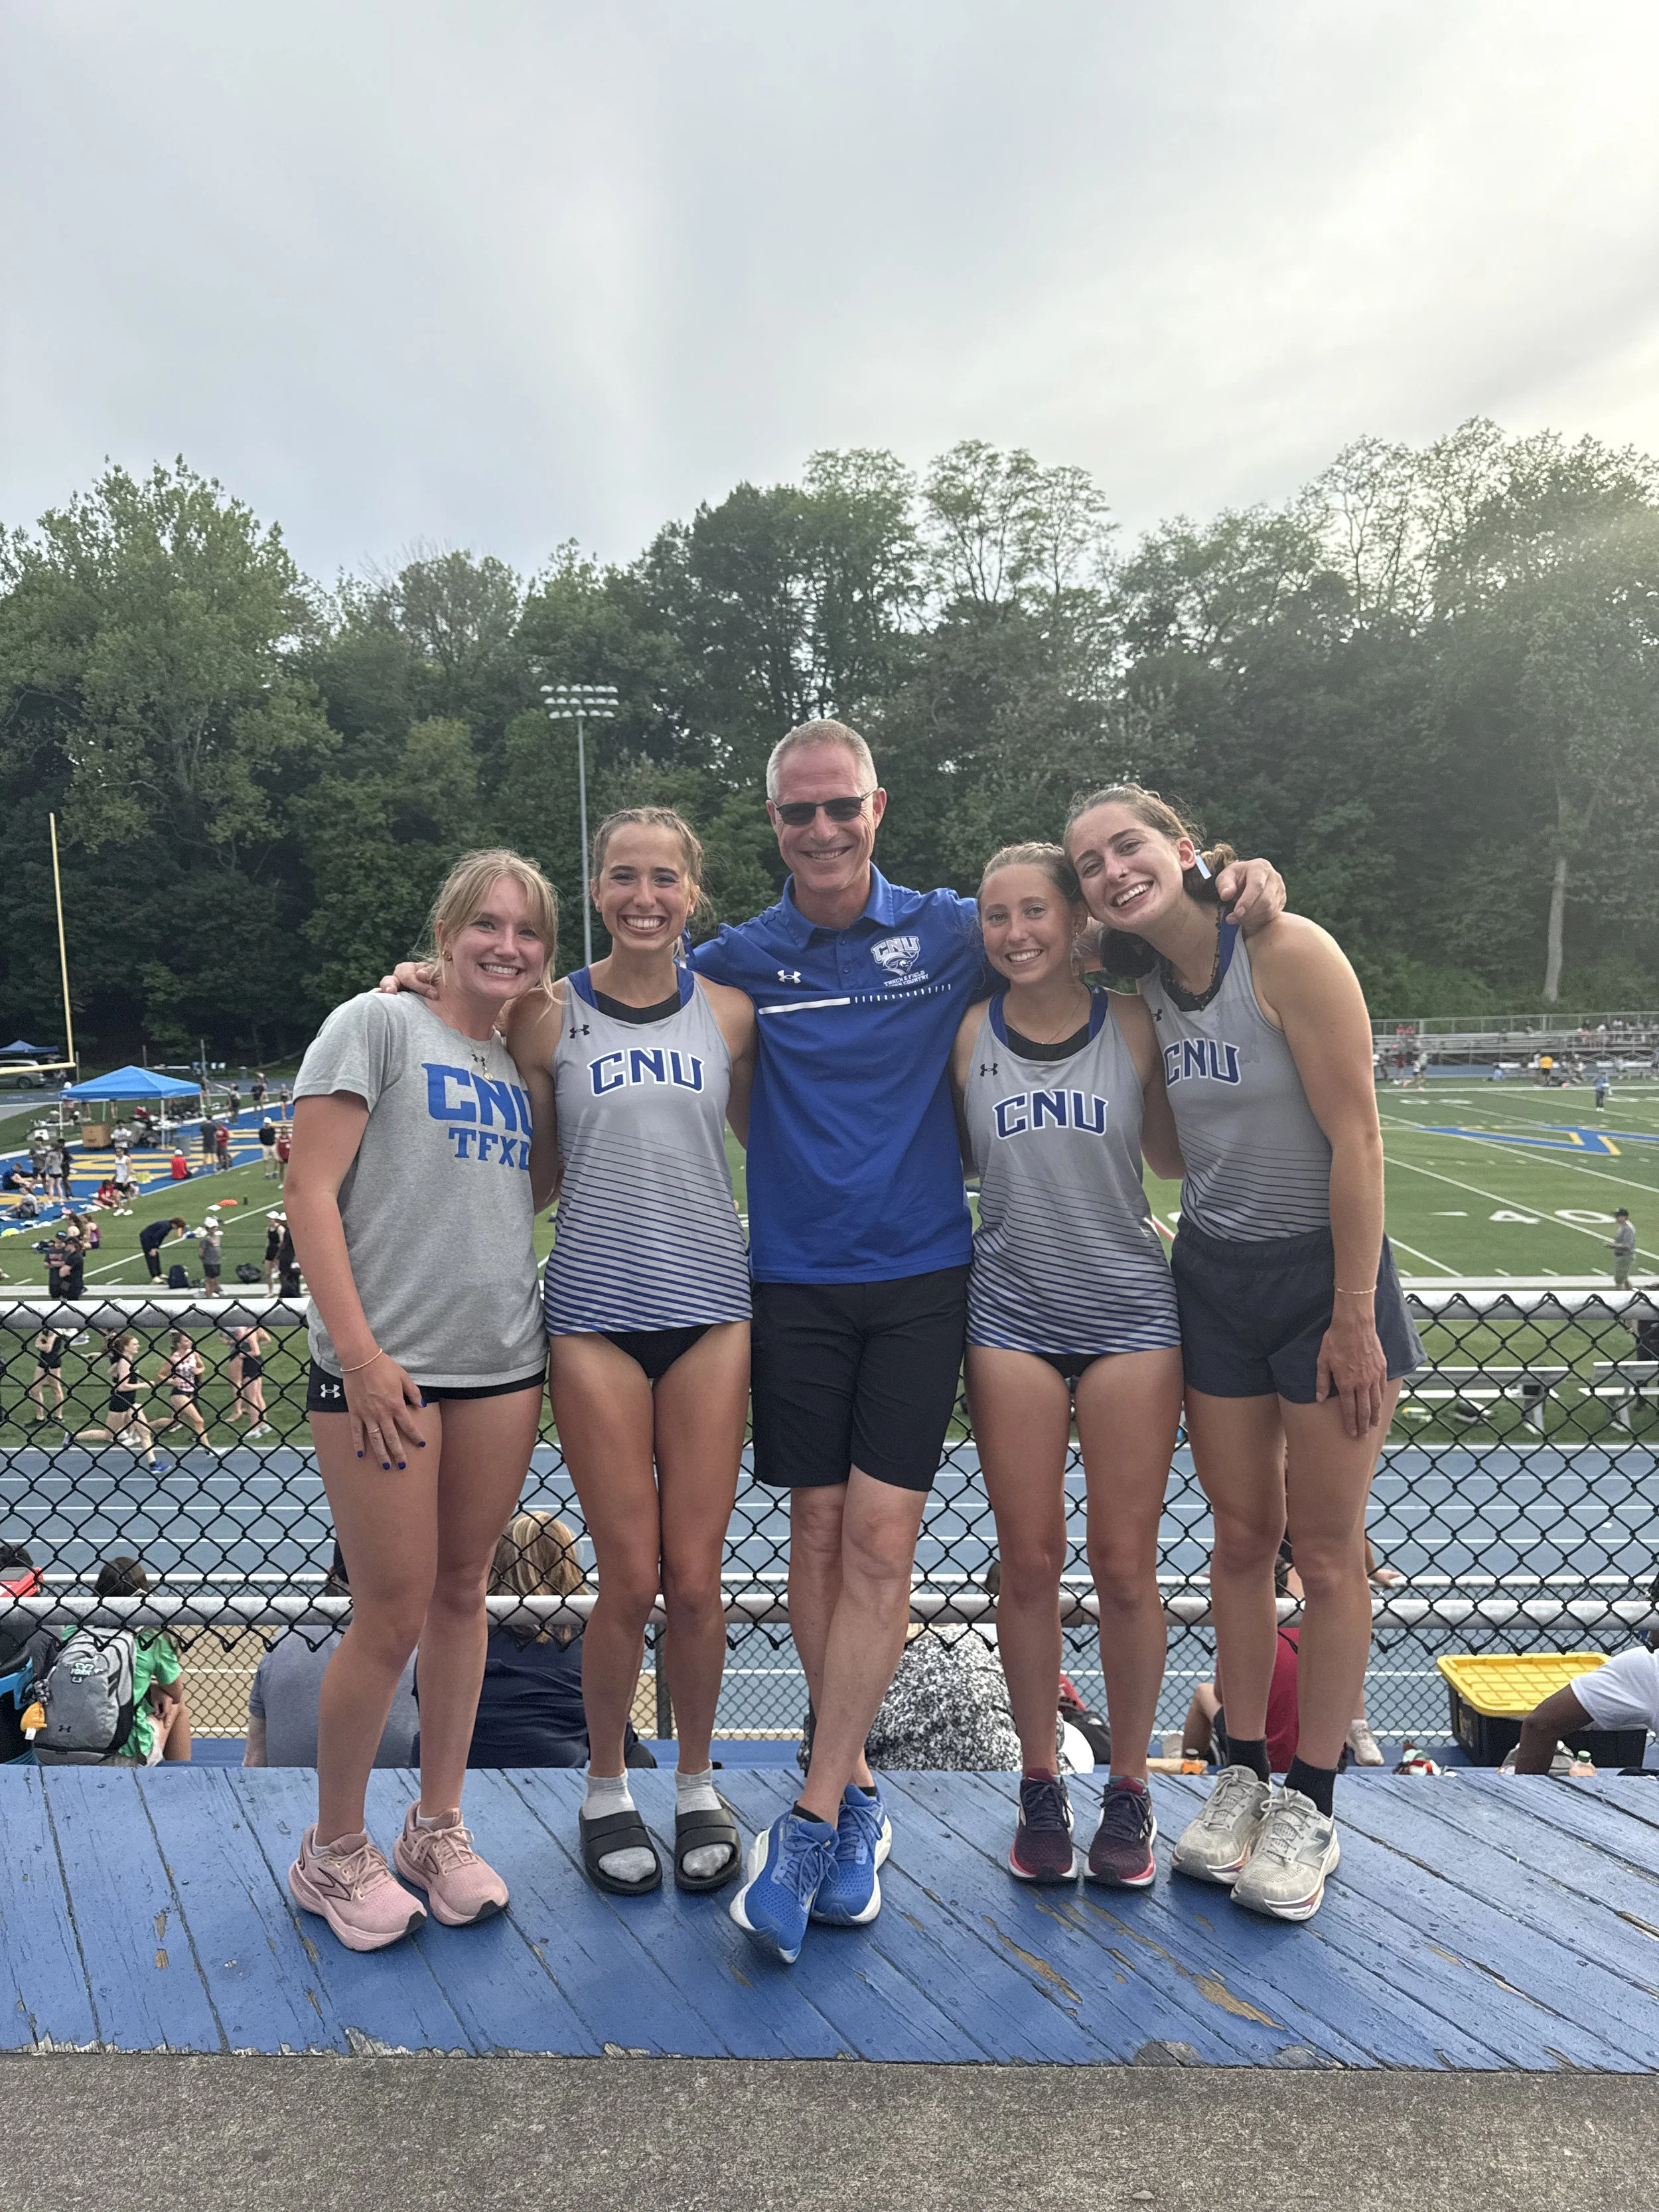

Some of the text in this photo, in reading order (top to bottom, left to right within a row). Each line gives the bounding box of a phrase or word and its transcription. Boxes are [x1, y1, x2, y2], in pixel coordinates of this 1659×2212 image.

[871, 936, 919, 962] CNU
[883, 977, 903, 987] TRACK
[908, 970, 925, 980] FIELD
[902, 974, 928, 985] COUNTRY
[587, 1047, 705, 1097] CNU
[1163, 1037, 1242, 1088] CNU
[992, 1088, 1109, 1140] CNU
